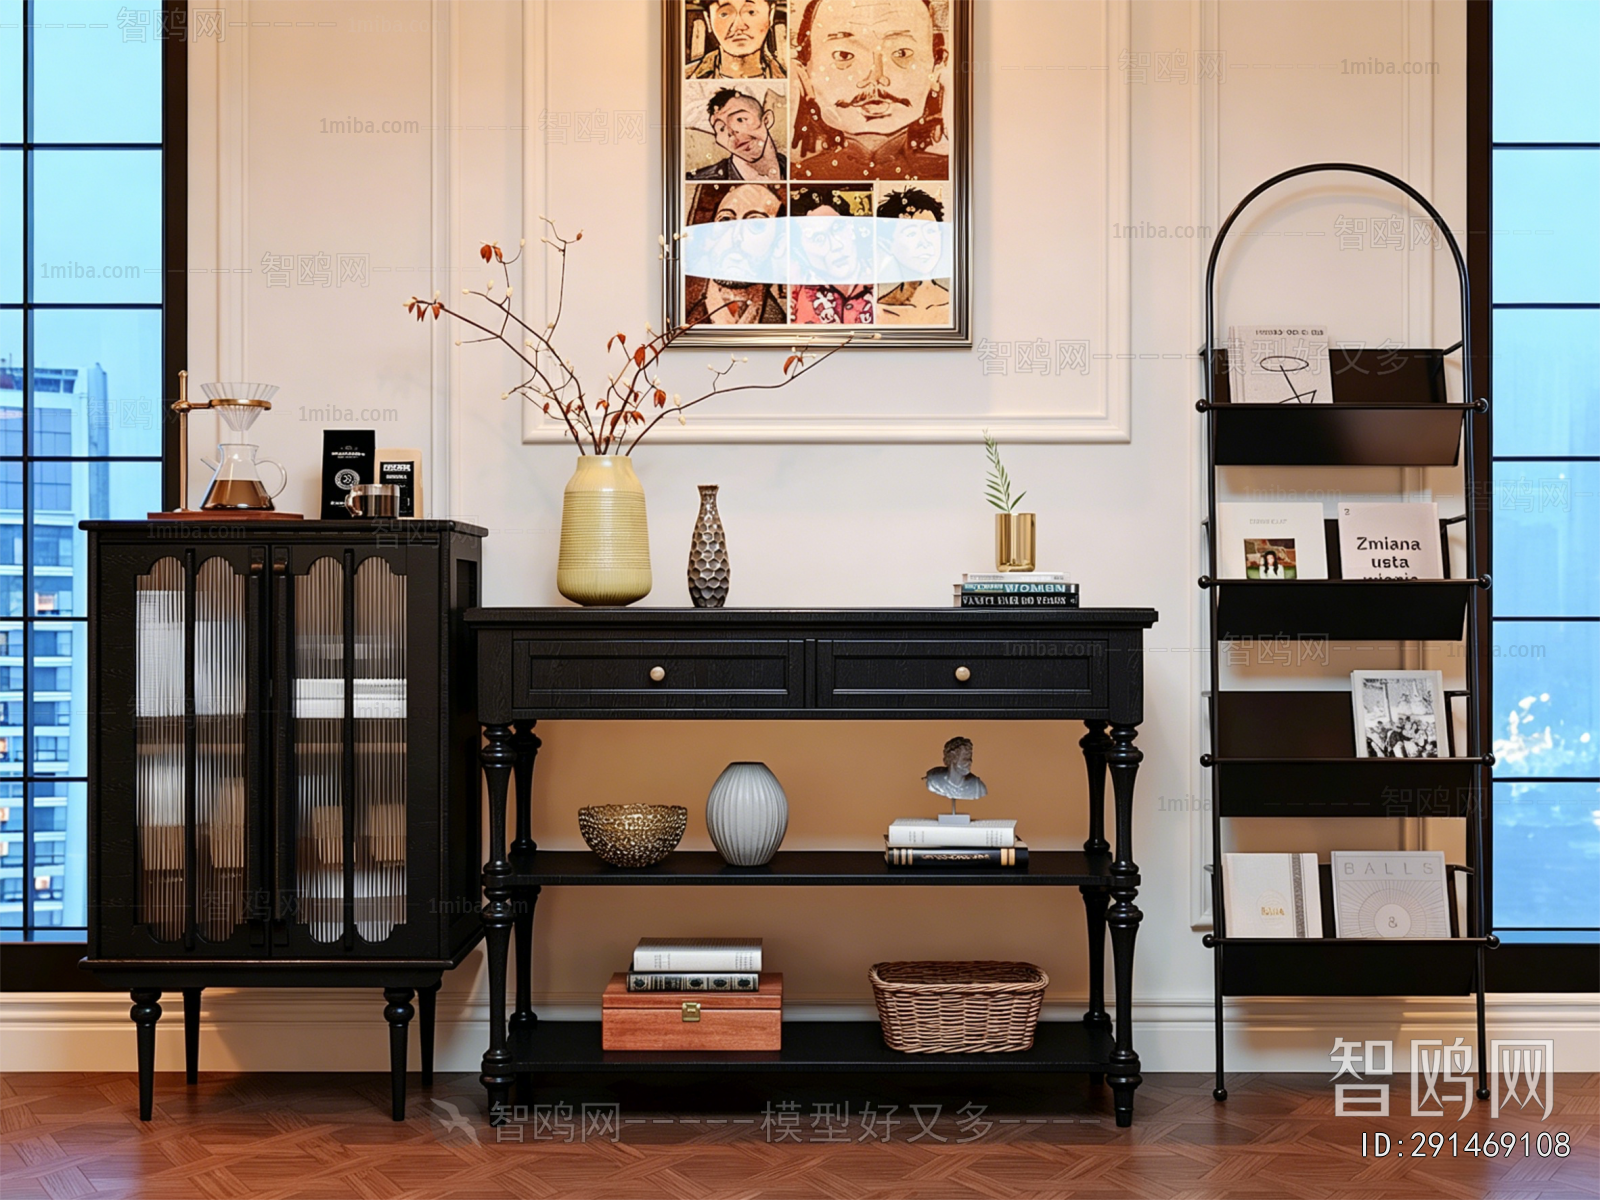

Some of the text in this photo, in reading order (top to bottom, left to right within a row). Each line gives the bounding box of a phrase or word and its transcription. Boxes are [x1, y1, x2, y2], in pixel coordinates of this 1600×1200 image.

[1356, 536, 1421, 551] Zmiana
[1371, 556, 1410, 569] usta
[1344, 862, 1434, 875] BALLS
[1388, 916, 1398, 928] &
